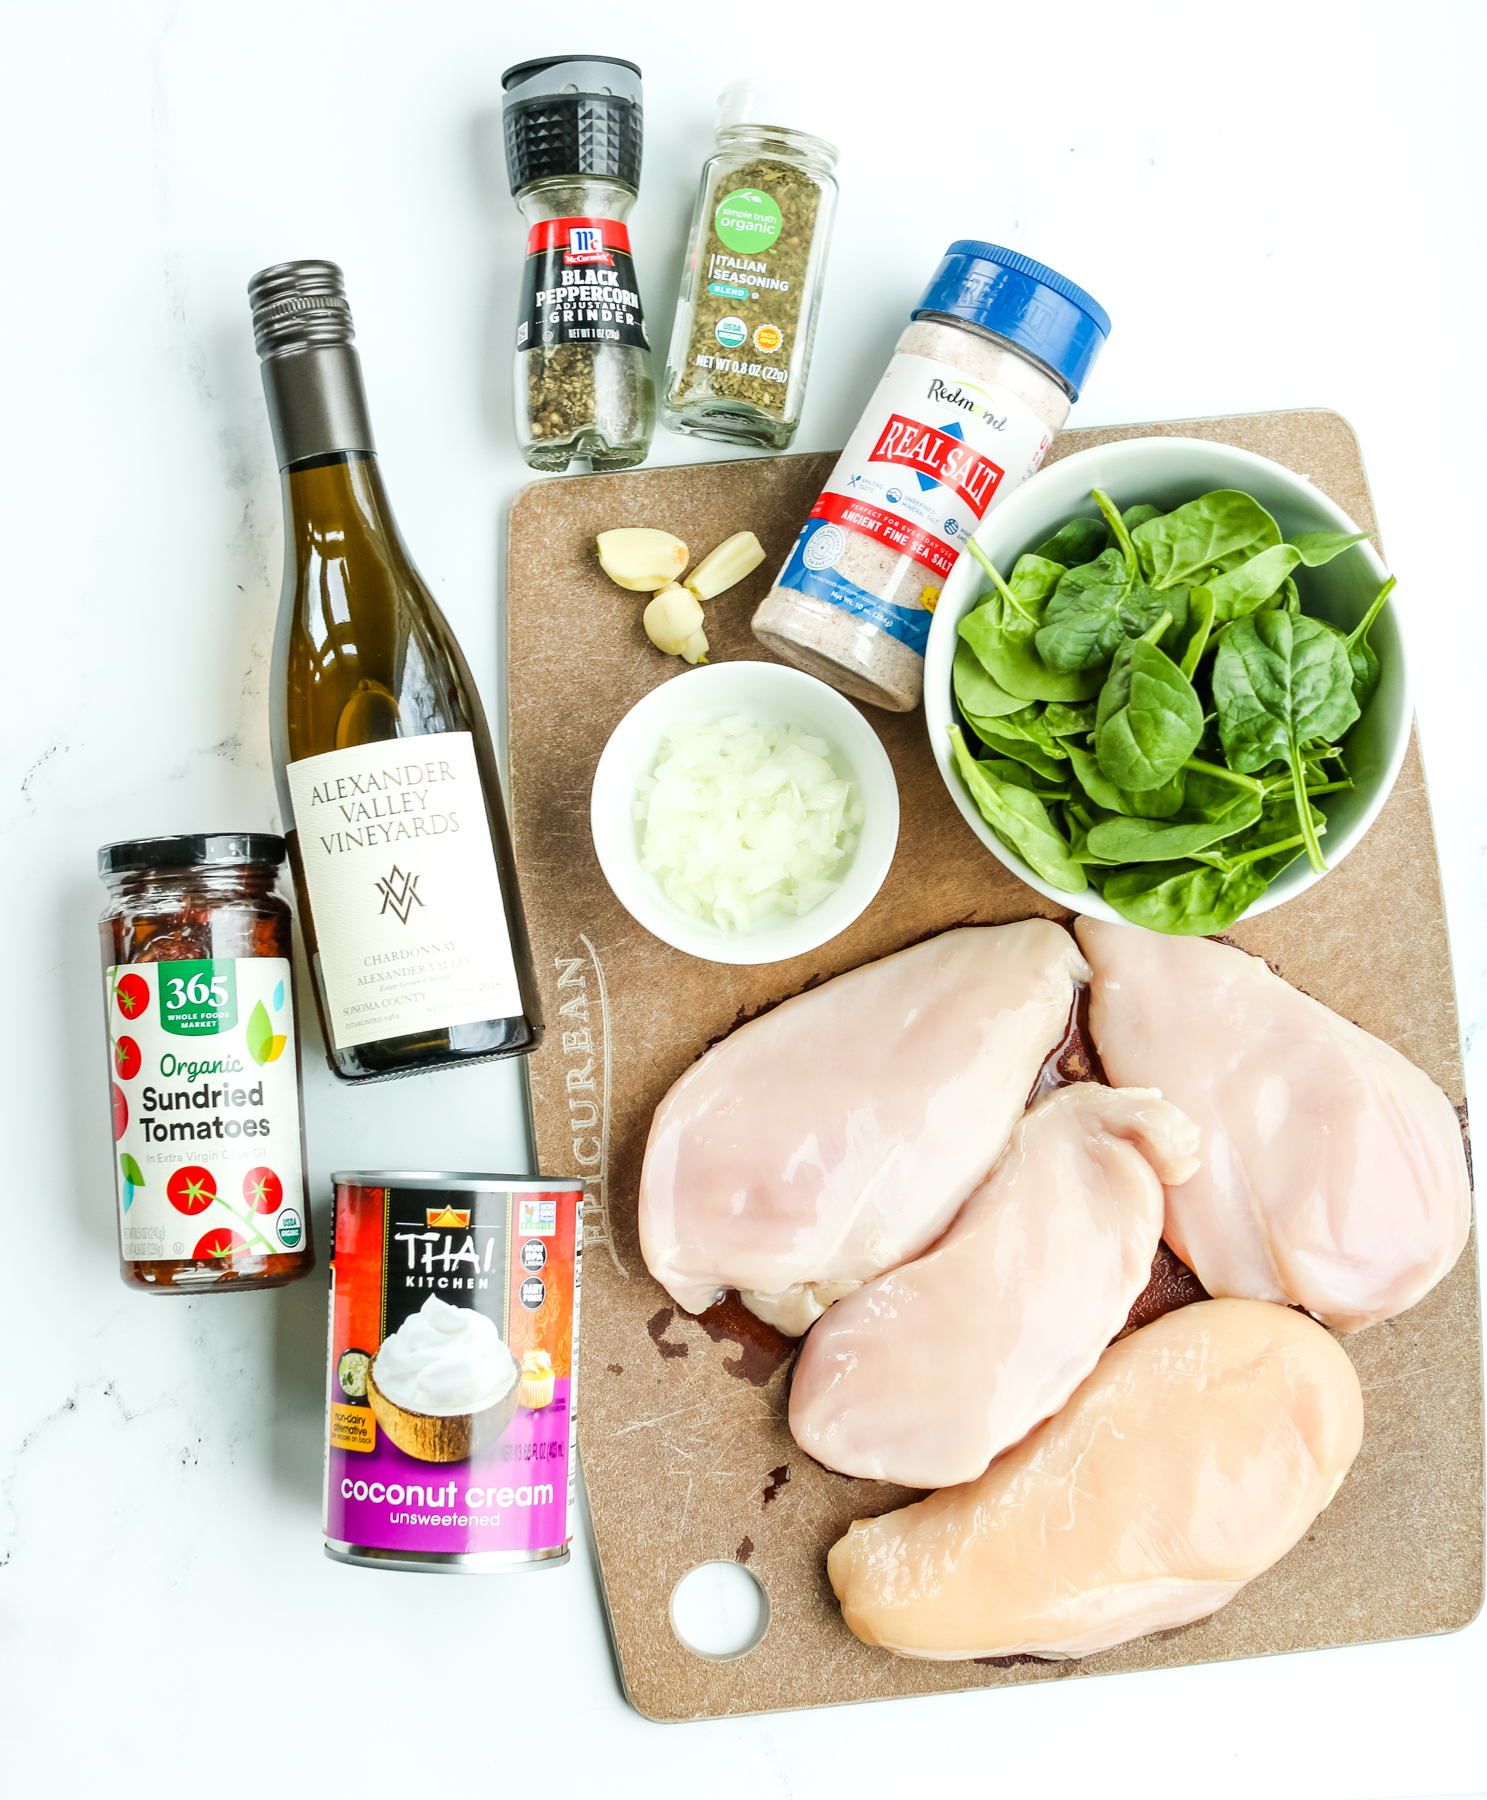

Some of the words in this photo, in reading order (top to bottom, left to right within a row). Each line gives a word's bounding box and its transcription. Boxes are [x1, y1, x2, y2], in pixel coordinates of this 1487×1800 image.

[723, 207, 752, 220] simple
[754, 213, 777, 224] truth
[721, 217, 775, 235] organic
[565, 254, 609, 264] McCormick
[715, 255, 767, 274] ITALIAN
[561, 270, 619, 287] BLACK
[713, 269, 790, 292] SEASONING
[536, 286, 639, 309] PEPPERCORN
[714, 285, 745, 297] BLEND
[555, 302, 627, 312] ADJUSTABLE
[550, 309, 634, 325] GRINDER
[568, 329, 580, 338] NET
[581, 329, 590, 338] WT
[596, 329, 605, 338] OZ
[723, 322, 741, 332] USDA
[760, 337, 776, 345] GMO
[696, 354, 715, 369] NET
[715, 357, 732, 372] WT
[731, 360, 748, 374] 0.8
[748, 363, 762, 377] OZ
[762, 366, 788, 384] (22g)
[927, 379, 1008, 432] Redmond
[876, 421, 944, 468] REAL
[940, 448, 998, 506] SALT
[859, 484, 875, 494] TASTE
[861, 478, 884, 490] AMAZING
[901, 501, 925, 520] MINERAL
[926, 513, 939, 525] SALT
[904, 495, 936, 516] UNREFINED
[815, 530, 826, 539] THE
[851, 503, 882, 520] PERFECT
[884, 516, 900, 528] FOR
[902, 525, 939, 550] EVERYDAY
[940, 547, 953, 558] USE
[841, 510, 883, 532] ANCIENT
[883, 527, 910, 546] FINE
[910, 541, 929, 559] SEA
[931, 553, 953, 573] SALT
[825, 579, 838, 588] DOES
[831, 590, 843, 601] Net
[843, 595, 854, 606] Wt.
[855, 602, 864, 610] 10
[863, 608, 872, 616] oz.
[872, 611, 894, 628] (284g)
[311, 761, 456, 807] ALEXANDER
[338, 789, 429, 823] VALLEY
[320, 811, 460, 855] VINEYARDS
[363, 941, 457, 967] CHARDONNAY
[357, 964, 426, 987] ALEXANDER
[428, 957, 472, 972] VALLEY
[165, 972, 229, 1010] 365
[343, 1001, 380, 1016] SONOMA
[381, 992, 427, 1008] COUNTY
[168, 1013, 198, 1022] WHOLE
[200, 1011, 230, 1019] FOODS
[181, 1020, 217, 1029] MARKET
[160, 1053, 244, 1083] Organic
[142, 1081, 264, 1112] Sundried
[553, 957, 611, 1247] EPICUREAN
[140, 1116, 271, 1143] Tomatoes
[146, 1153, 155, 1164] In
[157, 1152, 183, 1163] Extra
[186, 1151, 219, 1164] Virgin
[221, 1149, 249, 1159] Olive
[252, 1148, 267, 1158] Oil
[282, 1218, 297, 1227] USDA
[281, 1229, 300, 1237] ORGANIC
[394, 1232, 494, 1274] THAI
[525, 1244, 544, 1253] NON
[525, 1252, 544, 1261] BPA
[406, 1276, 488, 1290] KITCHEN
[523, 1283, 544, 1294] DAIRY
[523, 1294, 543, 1302] FREE
[335, 1413, 366, 1427] non-dairy
[333, 1422, 367, 1437] alternative
[502, 1444, 512, 1461] NET
[340, 1477, 458, 1509] coconut
[464, 1481, 554, 1509] cream
[389, 1511, 501, 1528] unsweetened
